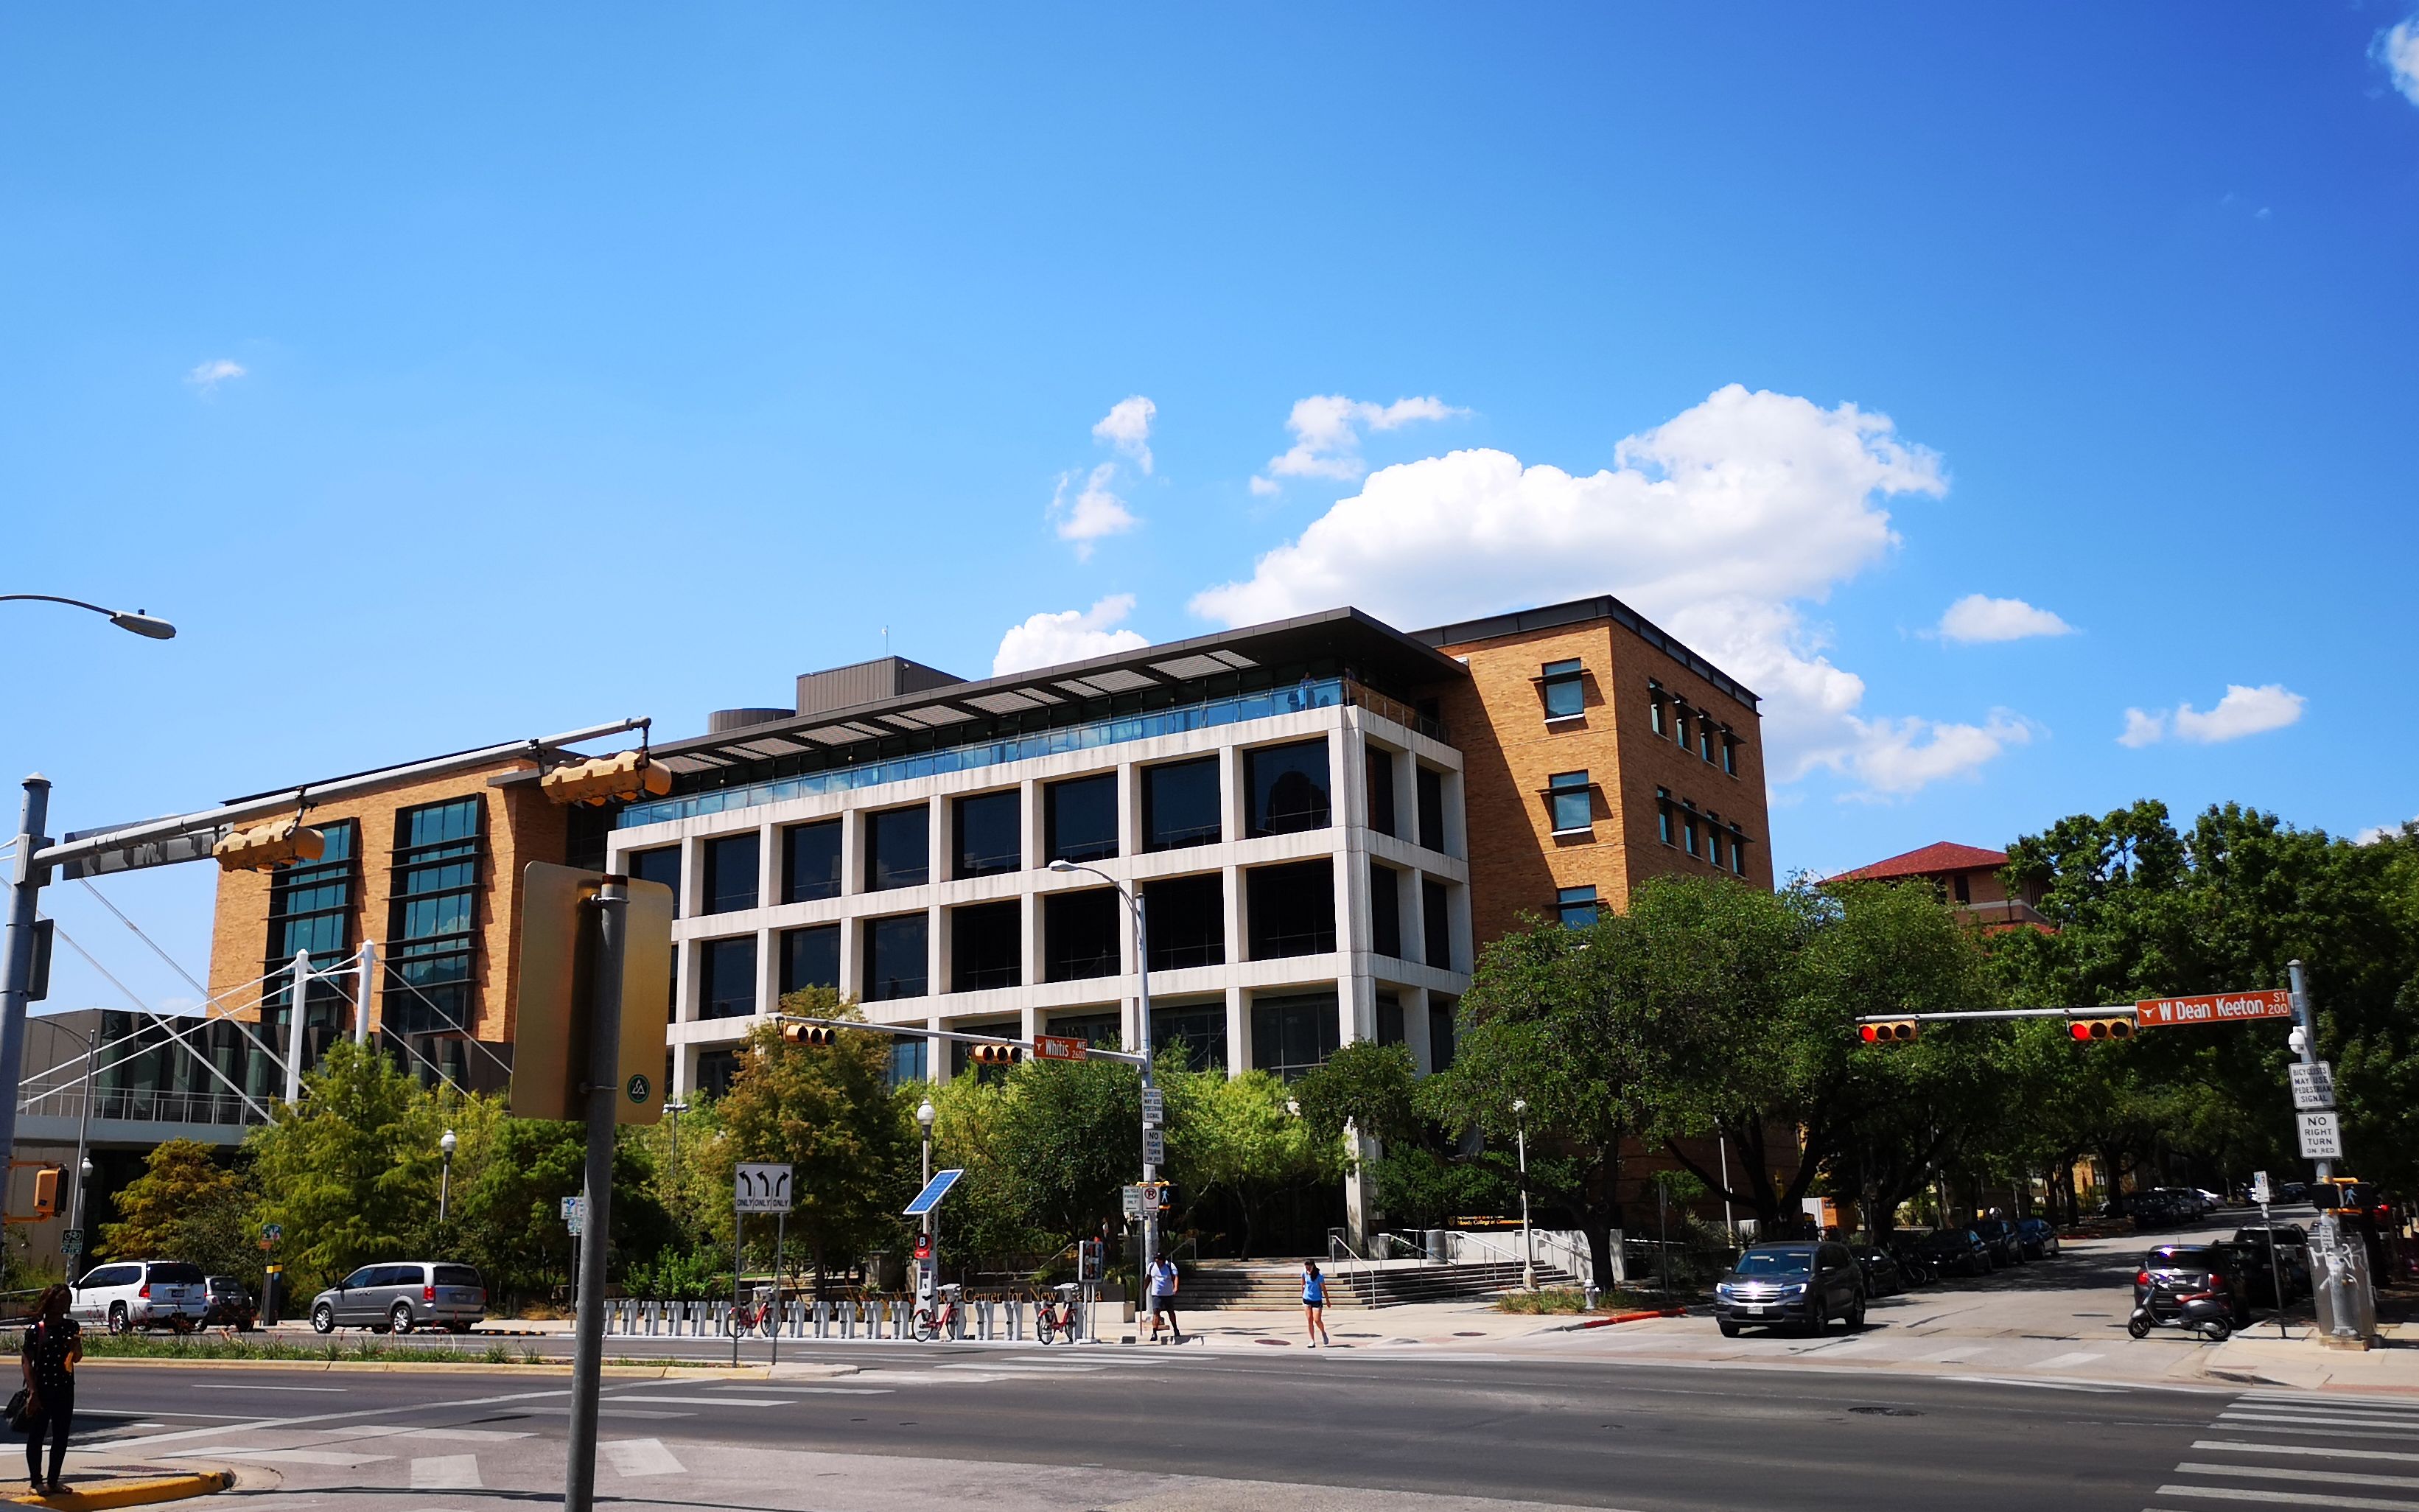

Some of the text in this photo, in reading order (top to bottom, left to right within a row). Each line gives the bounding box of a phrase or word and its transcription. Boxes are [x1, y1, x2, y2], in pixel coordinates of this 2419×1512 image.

[2273, 992, 2285, 1003] ST
[2158, 997, 2264, 1021] W Dean Keeton
[2267, 1004, 2288, 1015] 200
[1045, 1039, 1069, 1057] Whitis
[1077, 1041, 1086, 1050] AVE
[2293, 1067, 2327, 1076] BICYCLISTS
[2294, 1085, 2331, 1093] PEDESTRIAN
[2307, 1116, 2327, 1126] NO
[1149, 1132, 1158, 1140] NO
[737, 1199, 753, 1207] ONLY
[755, 1199, 771, 1207] ONLY
[773, 1199, 789, 1207] ONLY
[919, 1237, 926, 1247] B
[963, 1288, 1002, 1303] Center
[1007, 1286, 1023, 1303] for
[1029, 1287, 1057, 1301] New
